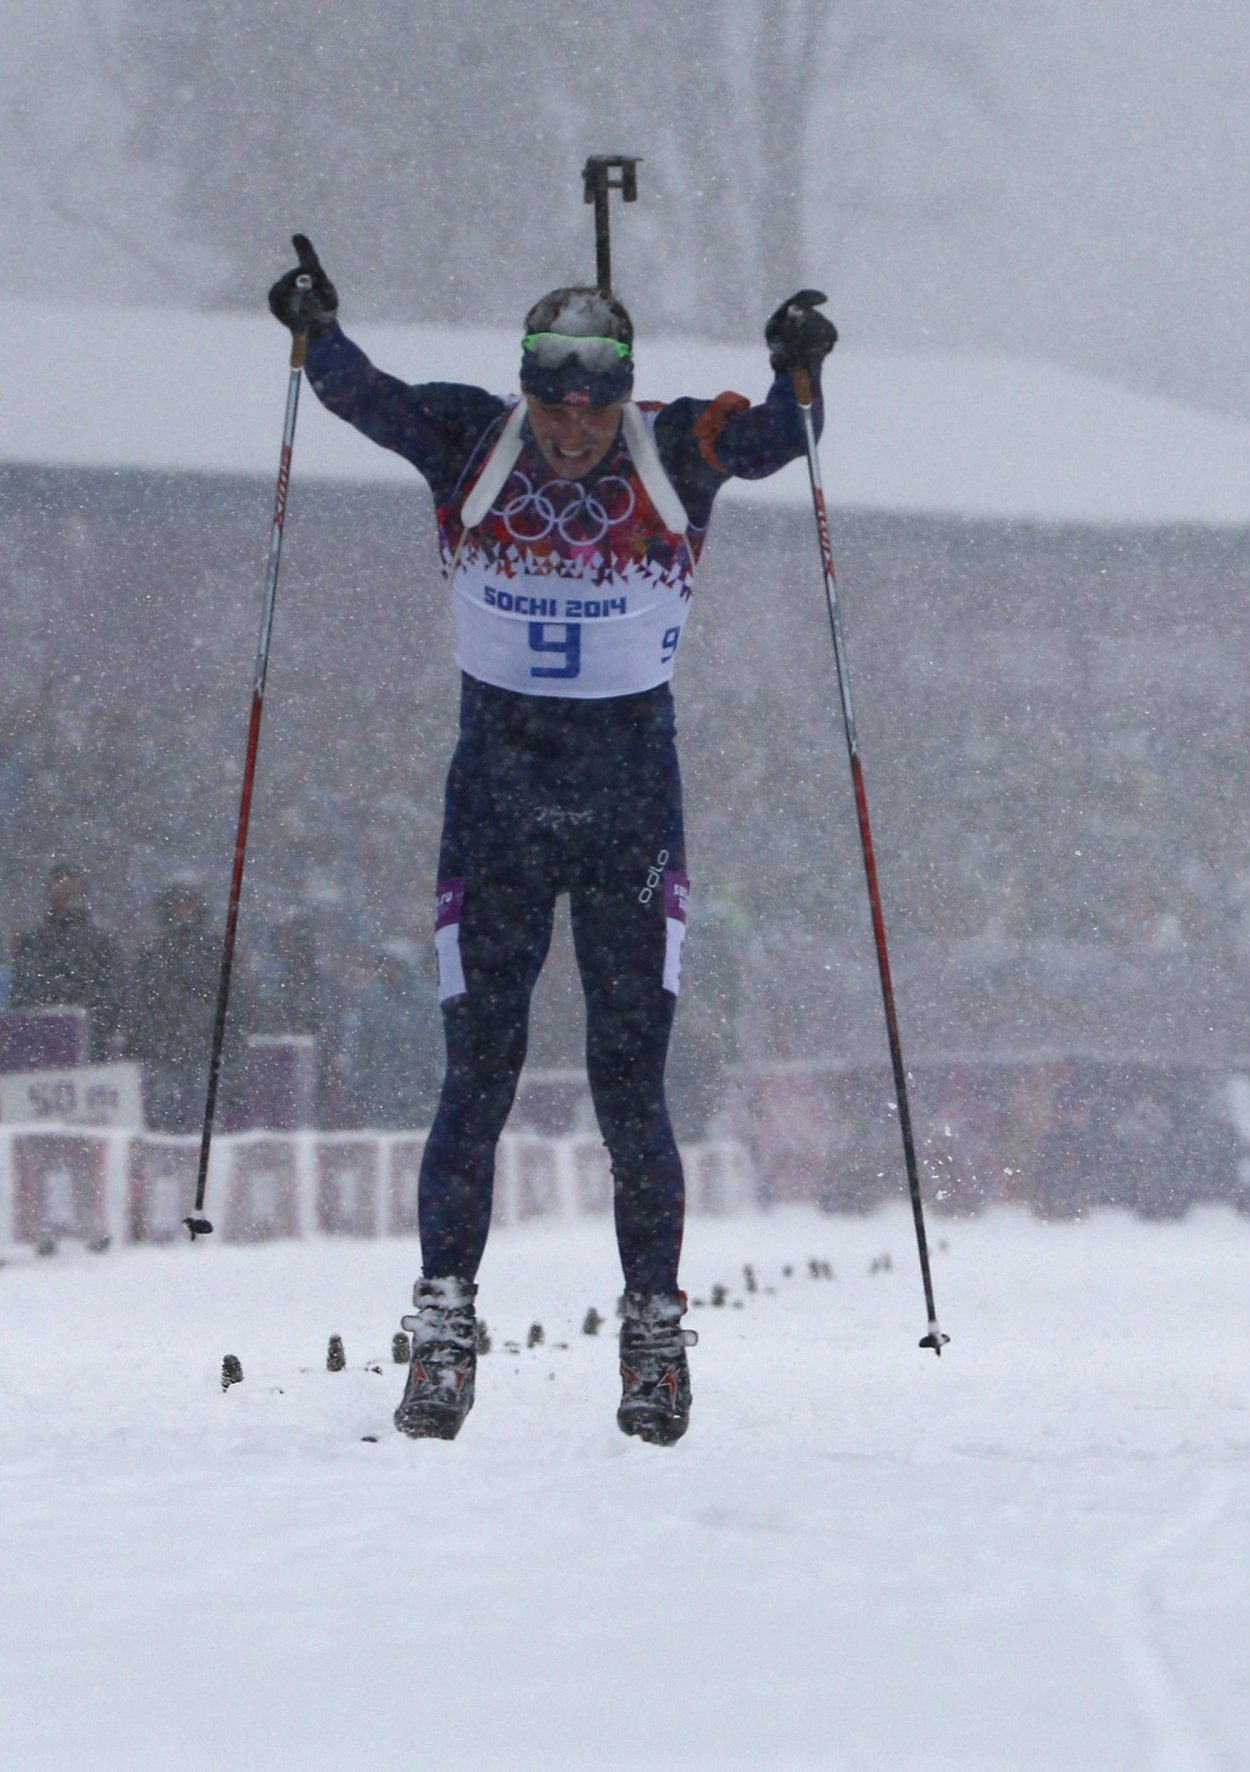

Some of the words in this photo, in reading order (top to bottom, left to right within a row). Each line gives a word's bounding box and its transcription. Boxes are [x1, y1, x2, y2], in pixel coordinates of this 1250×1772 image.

[483, 586, 556, 616] SOCHI
[565, 597, 628, 618] 2014
[528, 622, 581, 679] 9
[661, 625, 681, 664] 9
